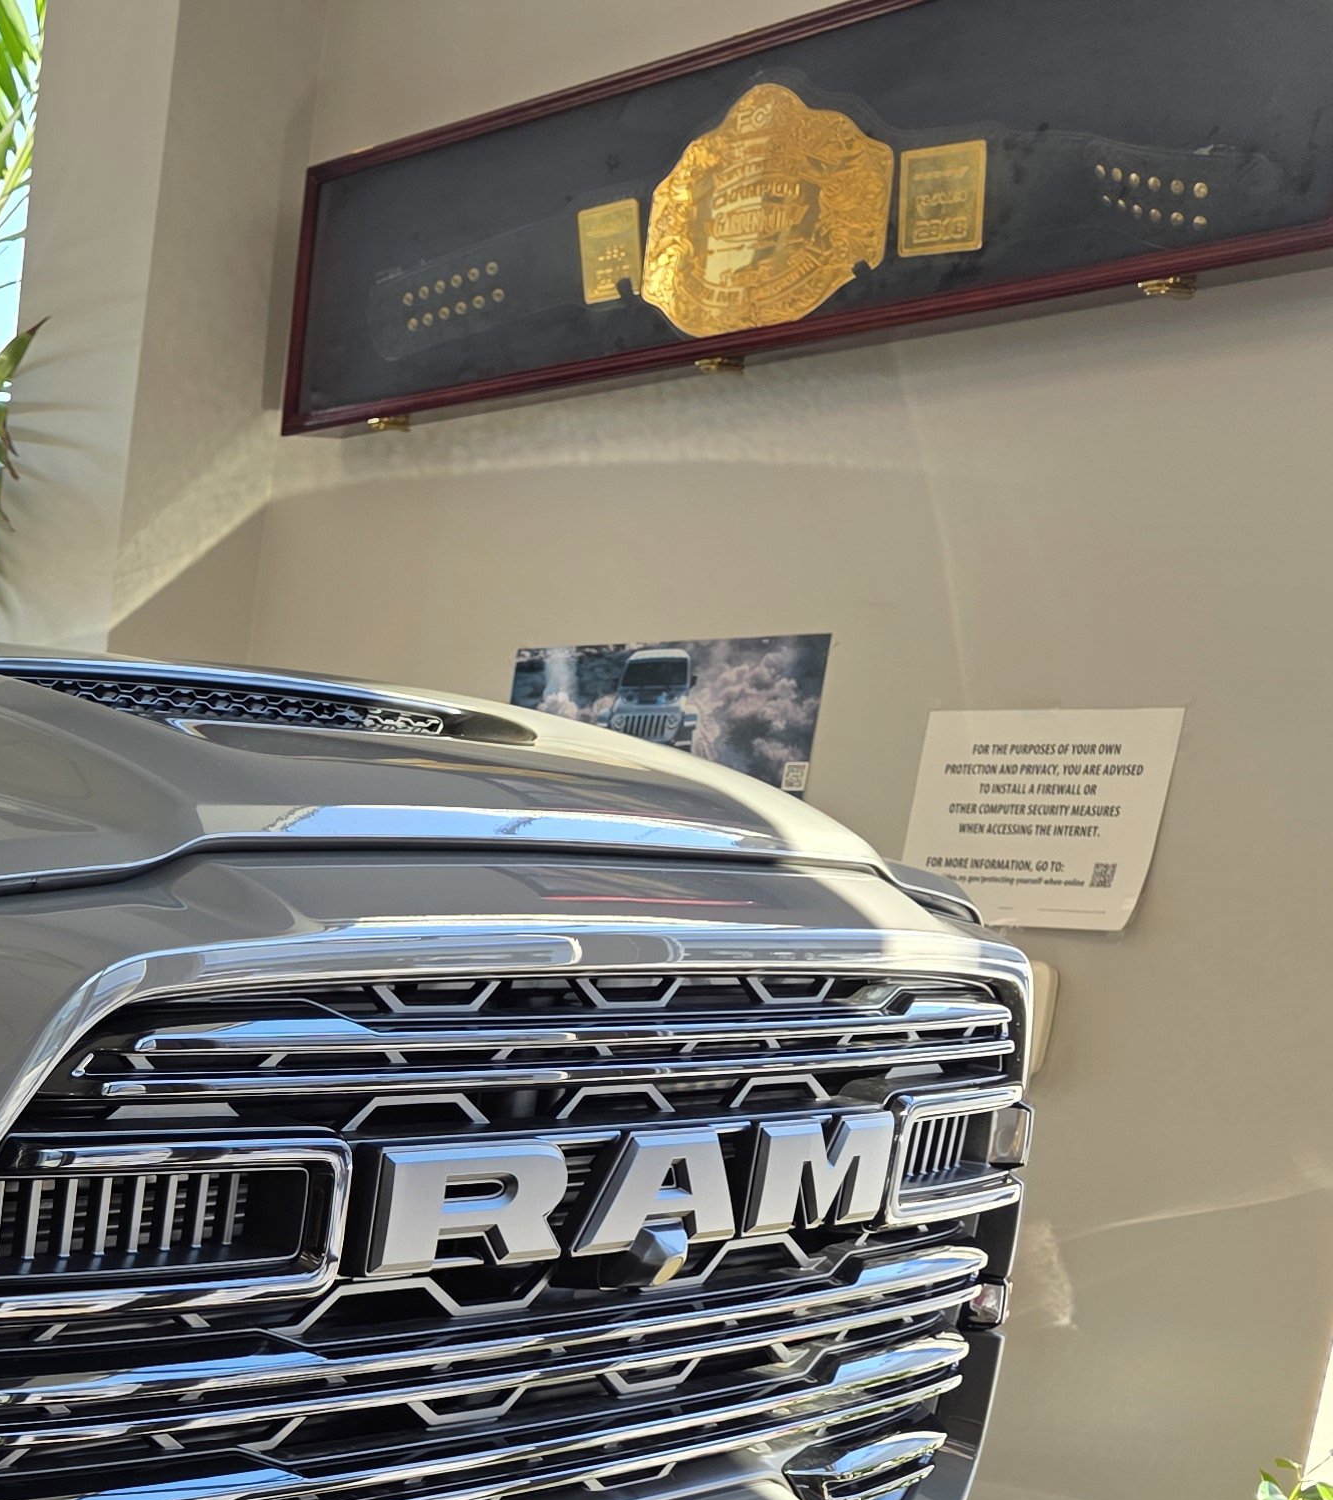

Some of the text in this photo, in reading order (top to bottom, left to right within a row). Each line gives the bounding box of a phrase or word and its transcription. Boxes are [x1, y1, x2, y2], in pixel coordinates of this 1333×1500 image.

[972, 743, 1122, 756] FOR THE PURPOSES OF YOUR OWN
[944, 763, 1144, 777] PROTECTION AND PRIVACY, YOU ARE ADVISED
[979, 783, 1097, 796] TO INSTALL A FIREWALL OR
[948, 803, 1121, 817] OTHER COMPUTER SECURITY MEASURES
[958, 822, 1101, 838] WHEN ACCESSING THE INTERNET.
[926, 856, 1065, 873] FOR MORE INFORMATION, GO TO:
[363, 1110, 896, 1277] RAM
